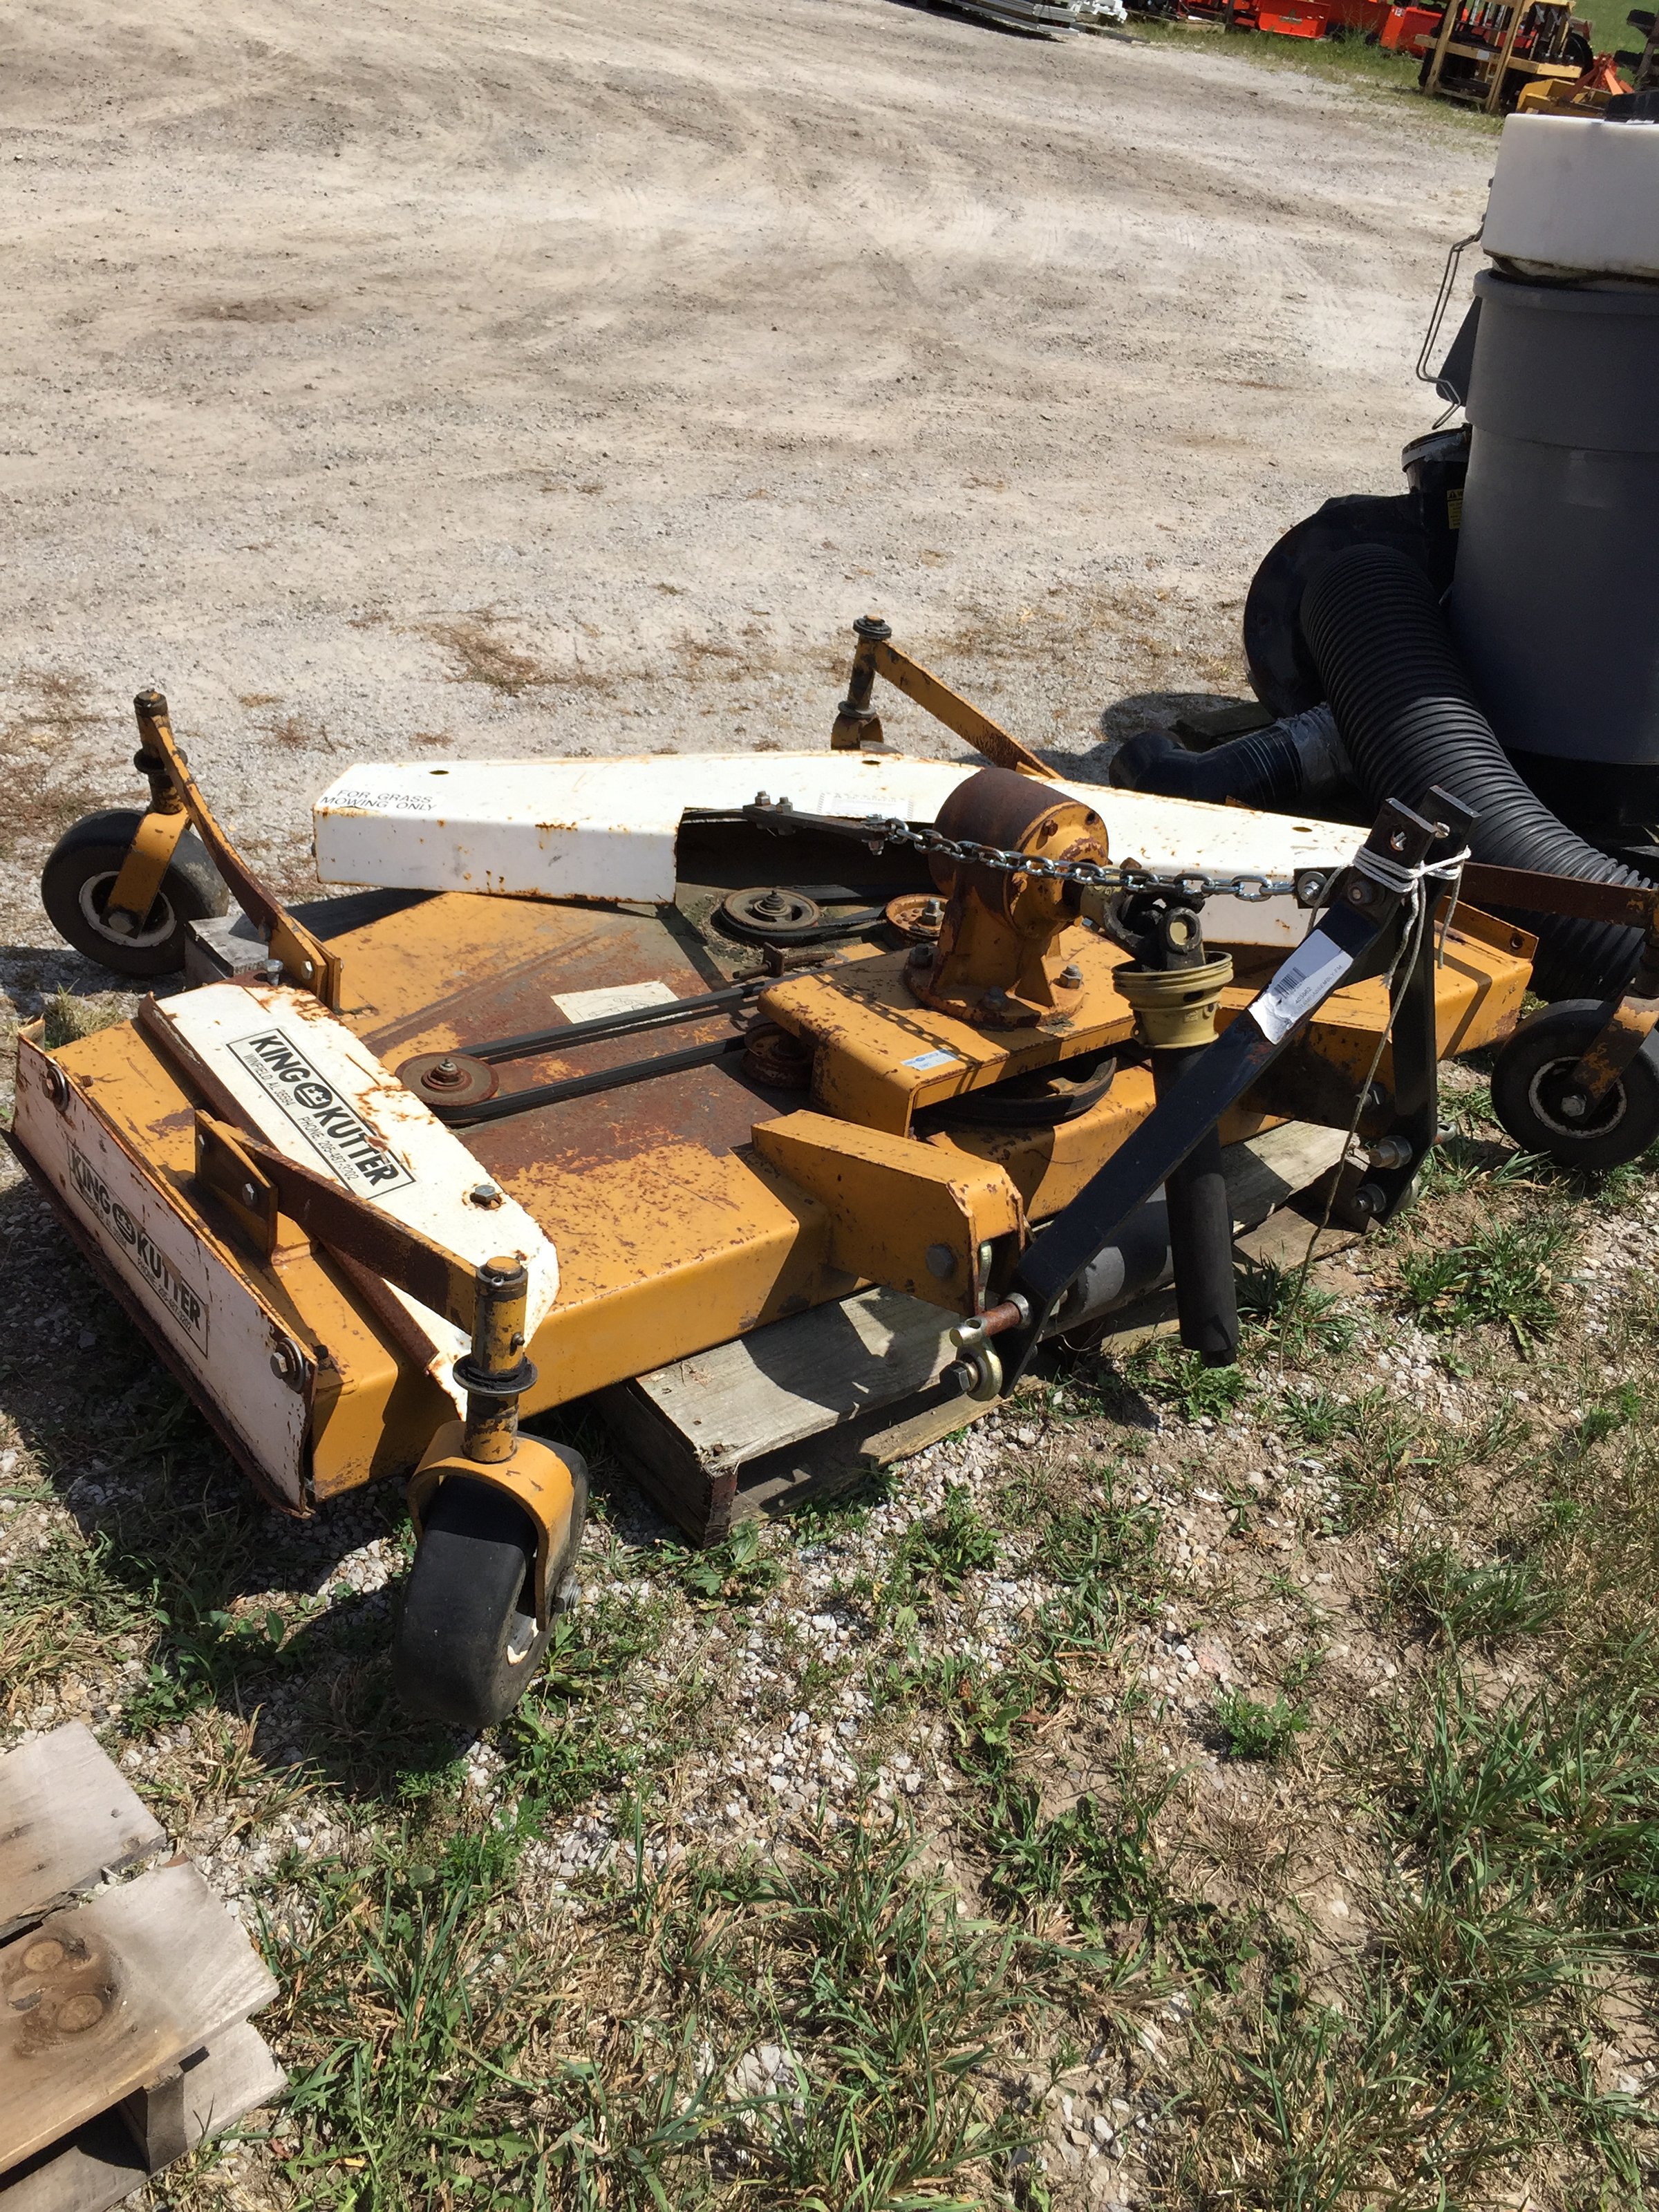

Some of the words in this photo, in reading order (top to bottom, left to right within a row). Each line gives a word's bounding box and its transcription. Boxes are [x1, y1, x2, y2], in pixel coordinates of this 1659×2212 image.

[320, 796, 389, 808] MOWING
[396, 803, 437, 812] ONLY
[378, 793, 433, 803] GRASS
[274, 1089, 296, 1106] 35594
[249, 1035, 310, 1082] KING
[312, 1106, 399, 1186] KUTTER
[71, 1147, 111, 1215] KING
[138, 1232, 200, 1331] KUTTER
